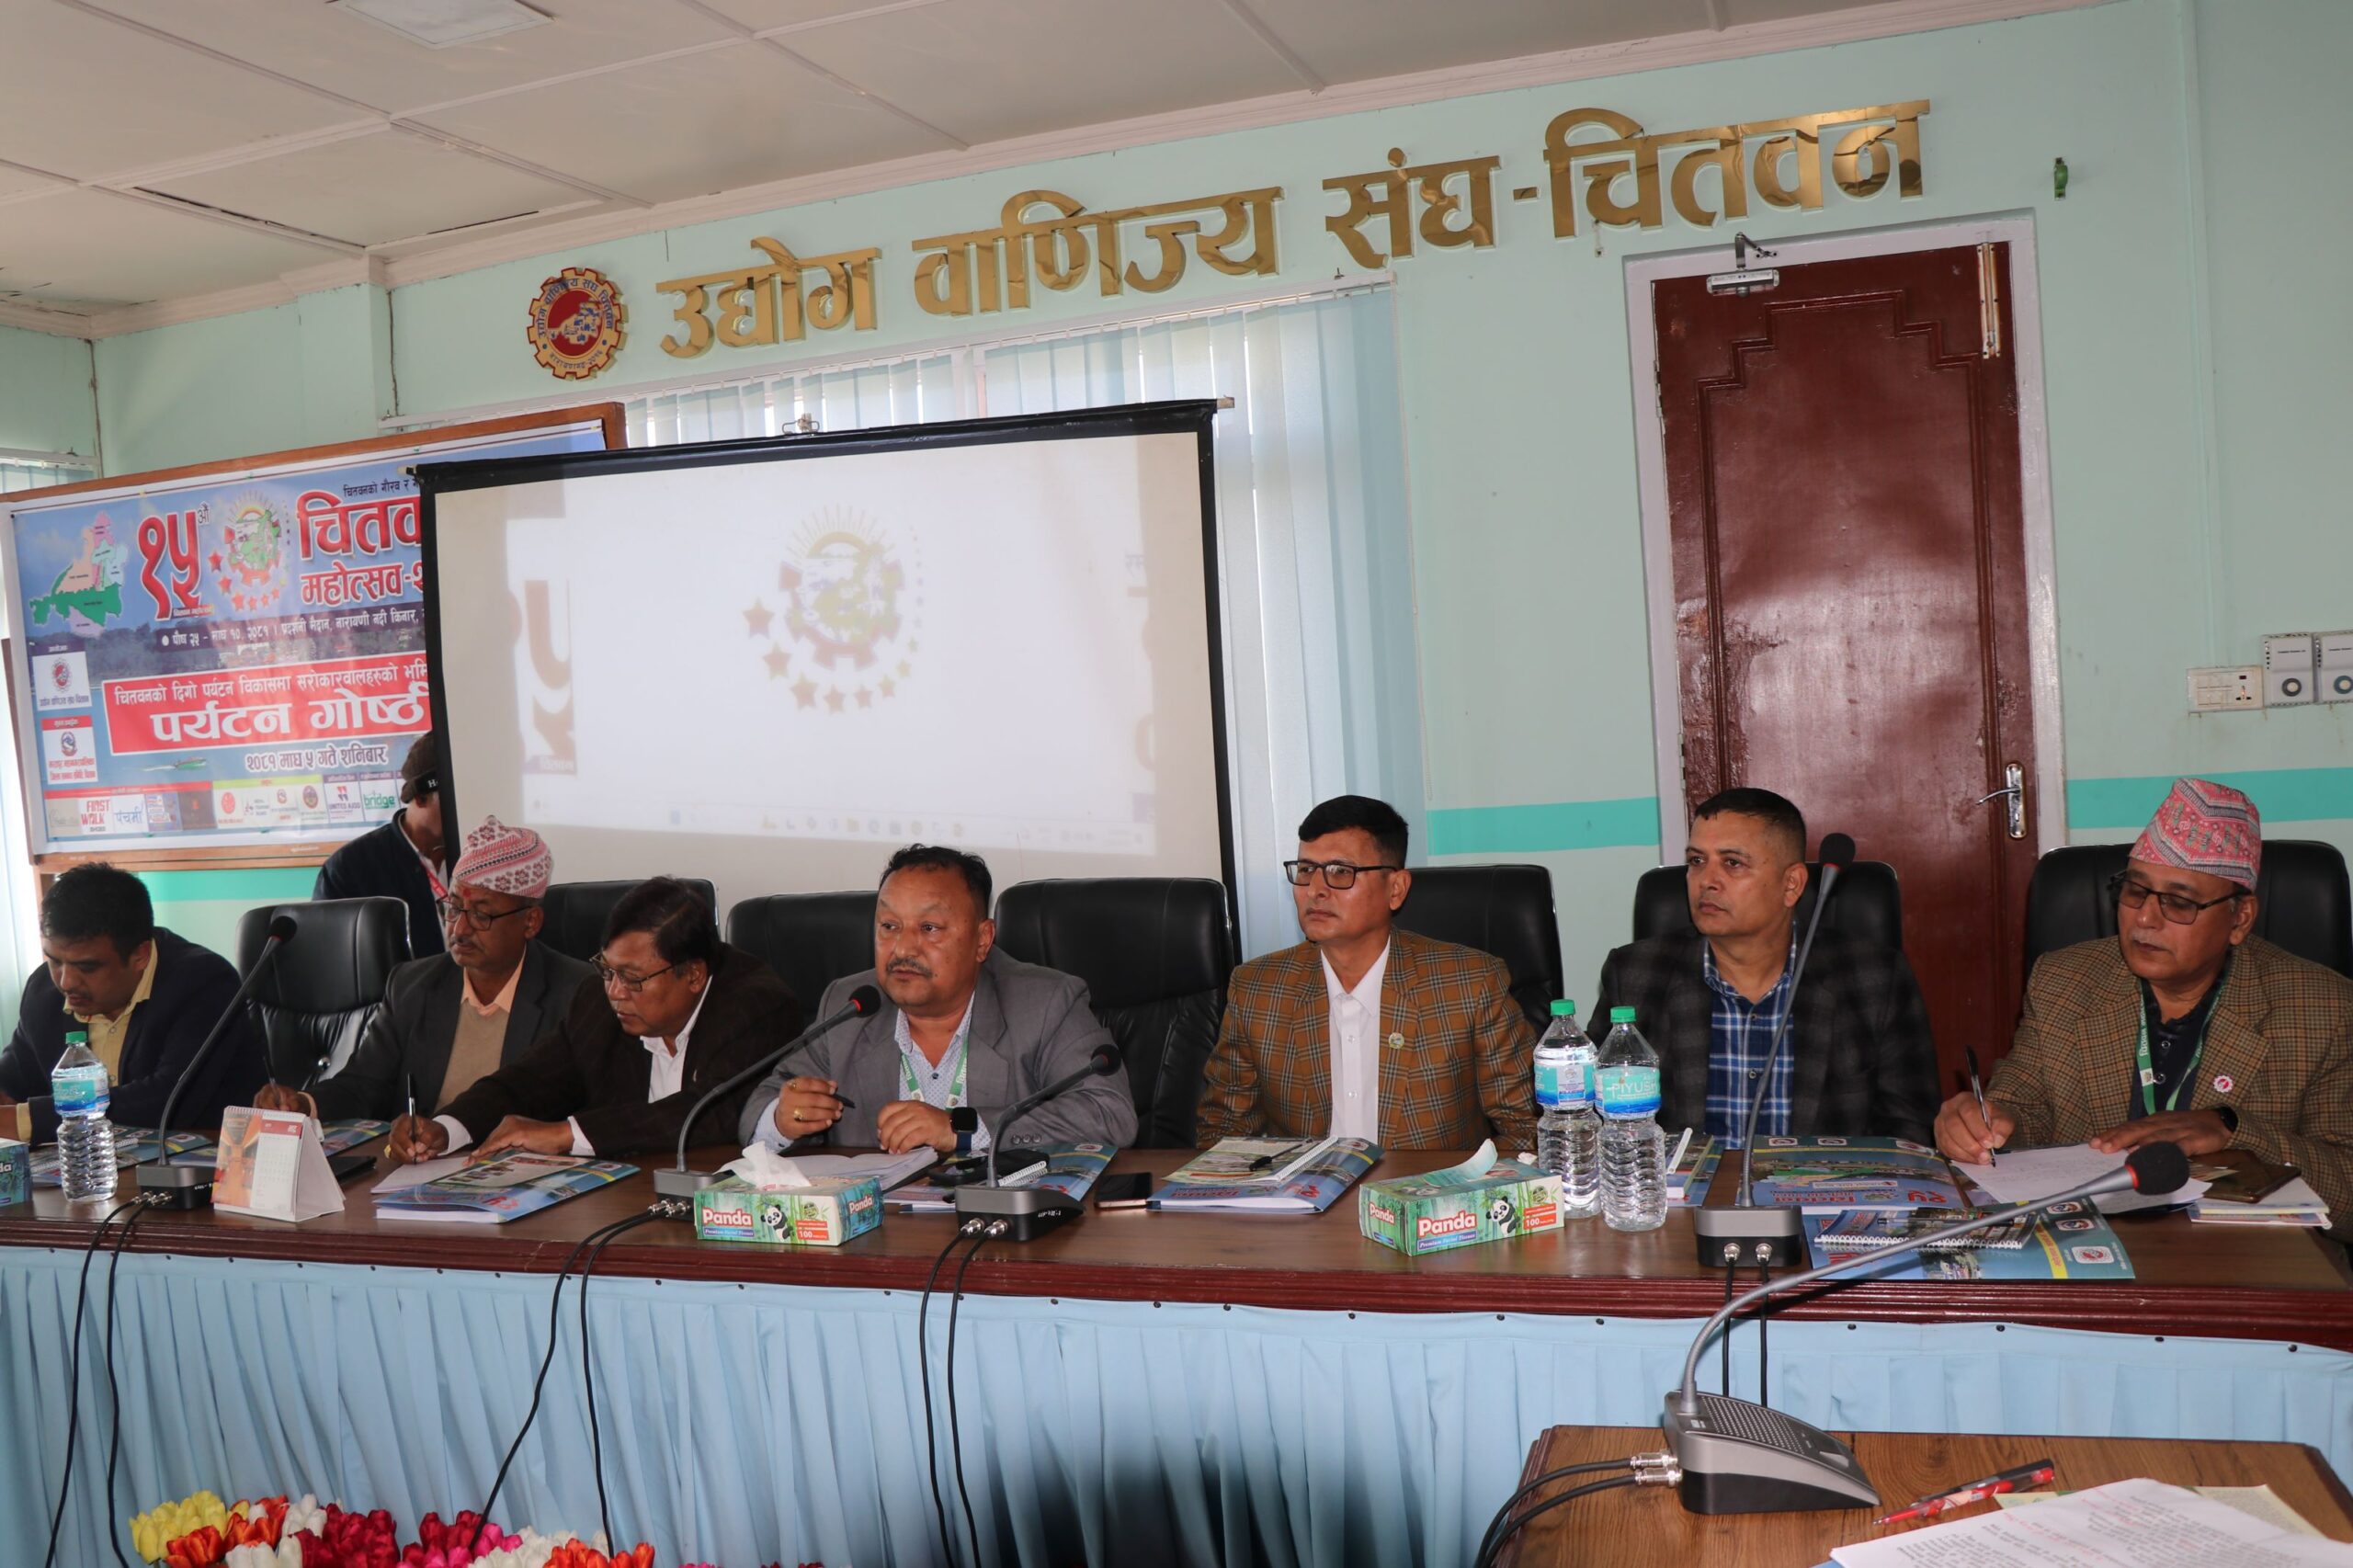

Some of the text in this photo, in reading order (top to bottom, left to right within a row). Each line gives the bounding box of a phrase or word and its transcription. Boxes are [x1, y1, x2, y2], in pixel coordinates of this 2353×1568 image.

[913, 188, 1284, 315] वाणिज्य
[404, 480, 410, 492] र
[139, 511, 199, 619] १५
[335, 610, 369, 631] नारायणी
[372, 608, 388, 627] नदी
[114, 683, 167, 706] चितवनको
[172, 680, 198, 702] दिगो
[202, 677, 234, 698] पर्यटन
[239, 674, 291, 695] विकासमा
[150, 700, 293, 742] पर्यटन
[246, 743, 386, 770] २०८१ माघ ५ गते शनिबार
[86, 800, 111, 812] FIRST
[363, 790, 395, 809] bridge
[849, 1195, 872, 1214] Panda
[1370, 1202, 1395, 1224] Panda
[702, 1206, 753, 1227] Panda
[1418, 1210, 1477, 1237] Panda
[1526, 1218, 1540, 1227] 100
[1419, 1240, 1441, 1248] Premium
